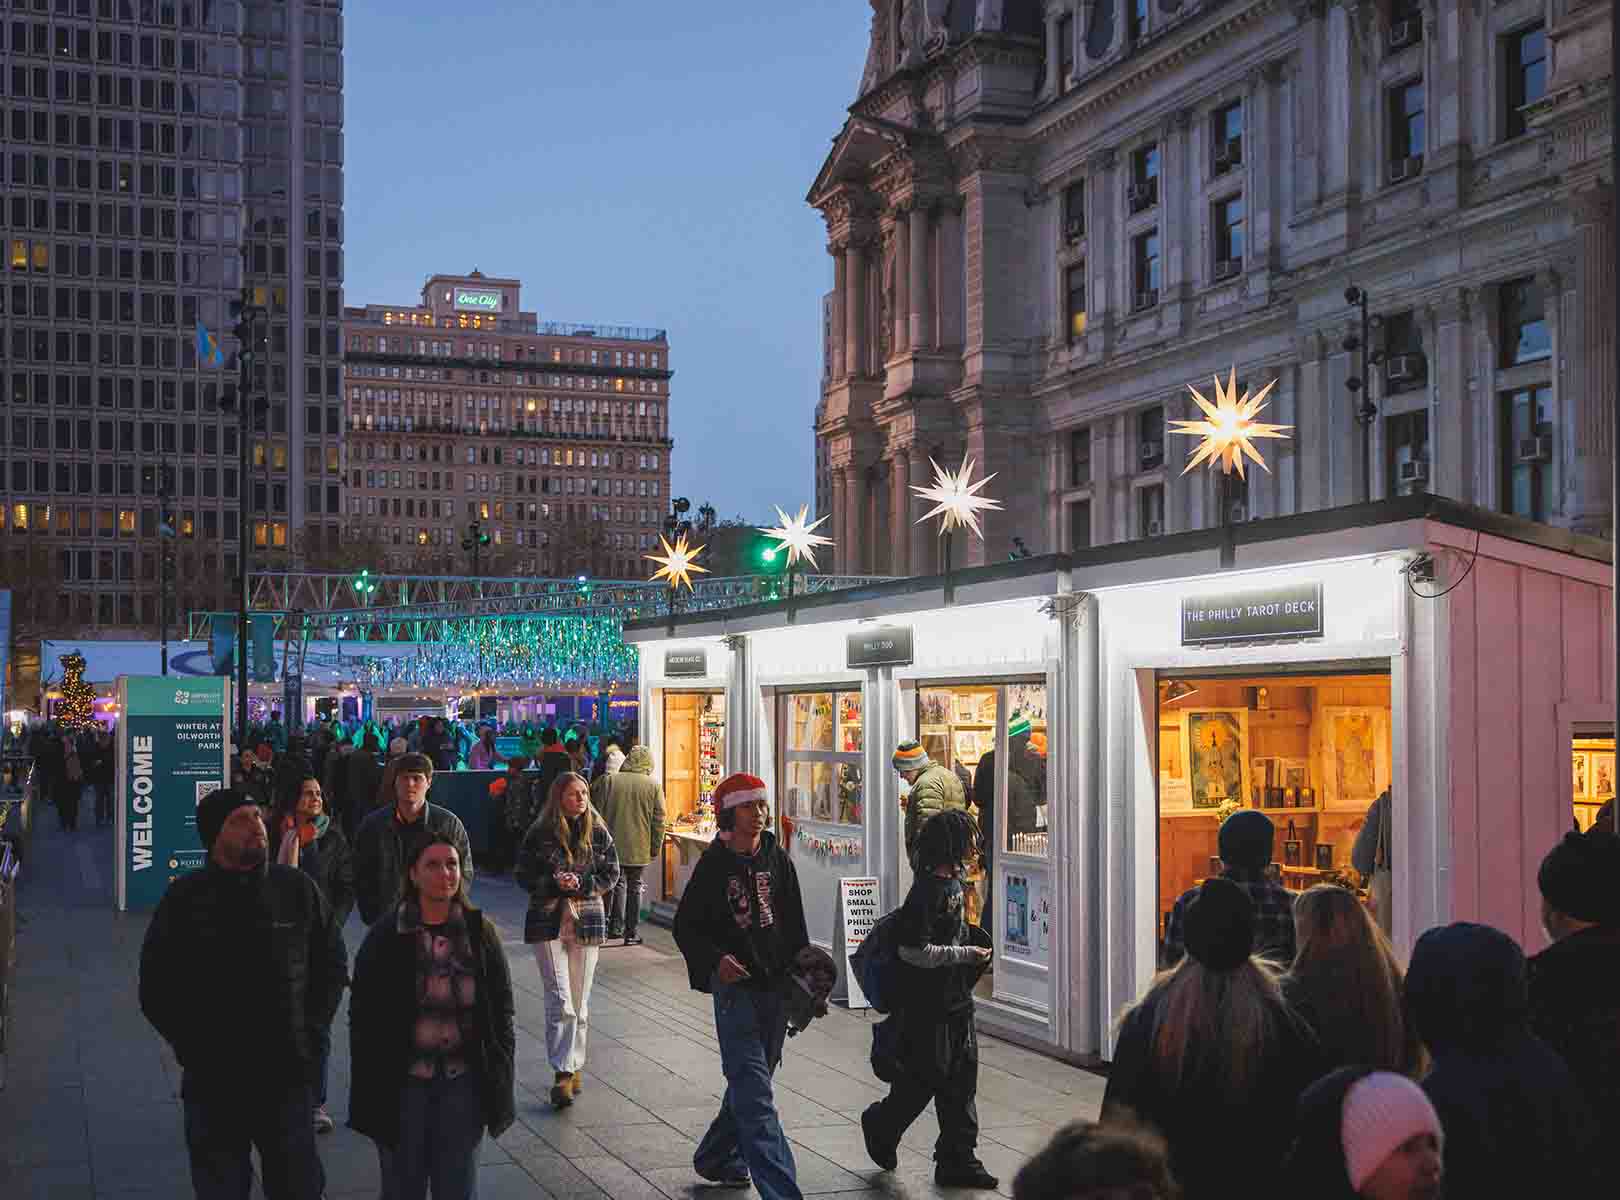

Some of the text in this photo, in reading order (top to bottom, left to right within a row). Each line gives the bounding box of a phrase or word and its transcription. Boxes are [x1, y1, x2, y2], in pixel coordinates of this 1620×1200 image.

[458, 294, 497, 308] One City
[1187, 600, 1315, 622] THE PHILLY TAROT DECK
[198, 742, 220, 750] PARK
[133, 735, 153, 872] WELCOME
